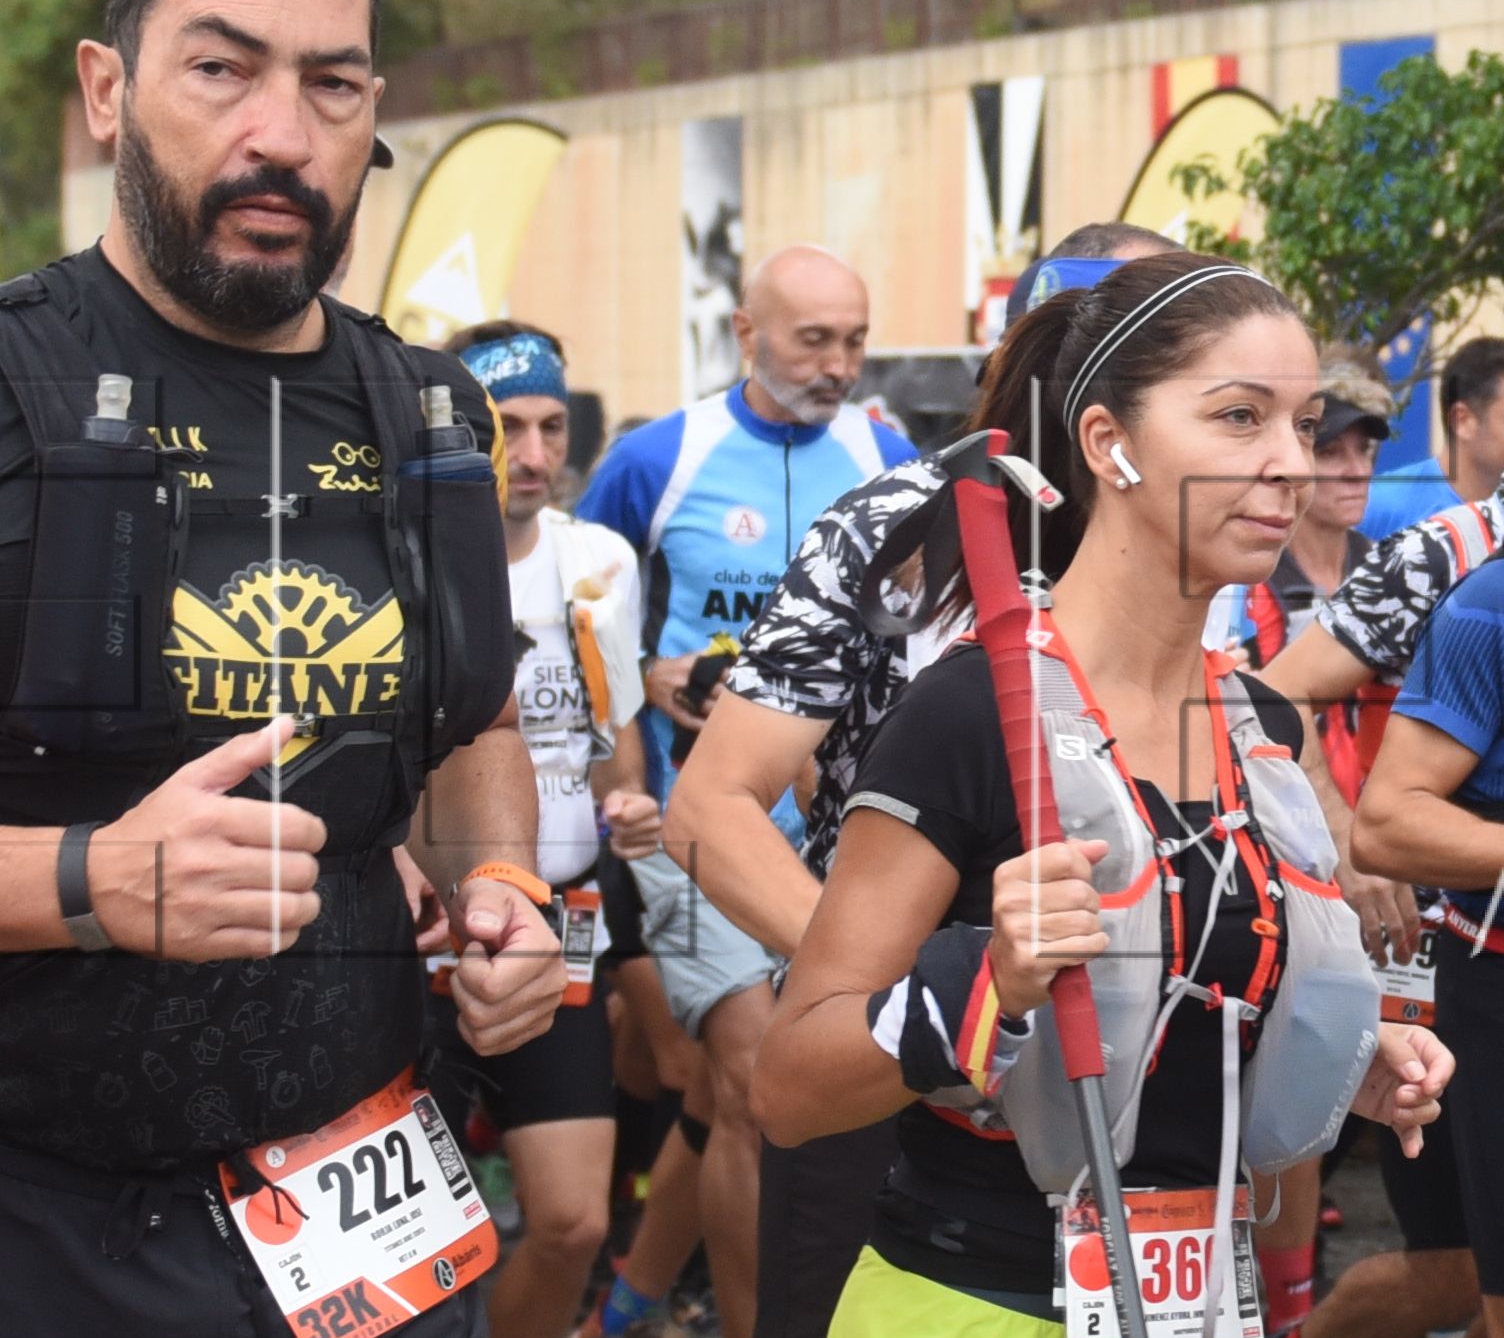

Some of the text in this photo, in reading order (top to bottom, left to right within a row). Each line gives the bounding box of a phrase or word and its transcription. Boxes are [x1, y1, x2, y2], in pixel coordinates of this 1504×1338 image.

[713, 568, 752, 587] club
[701, 588, 771, 624] AN
[316, 1128, 427, 1234] 222
[289, 1266, 312, 1293] 2
[1087, 1313, 1101, 1336] 2
